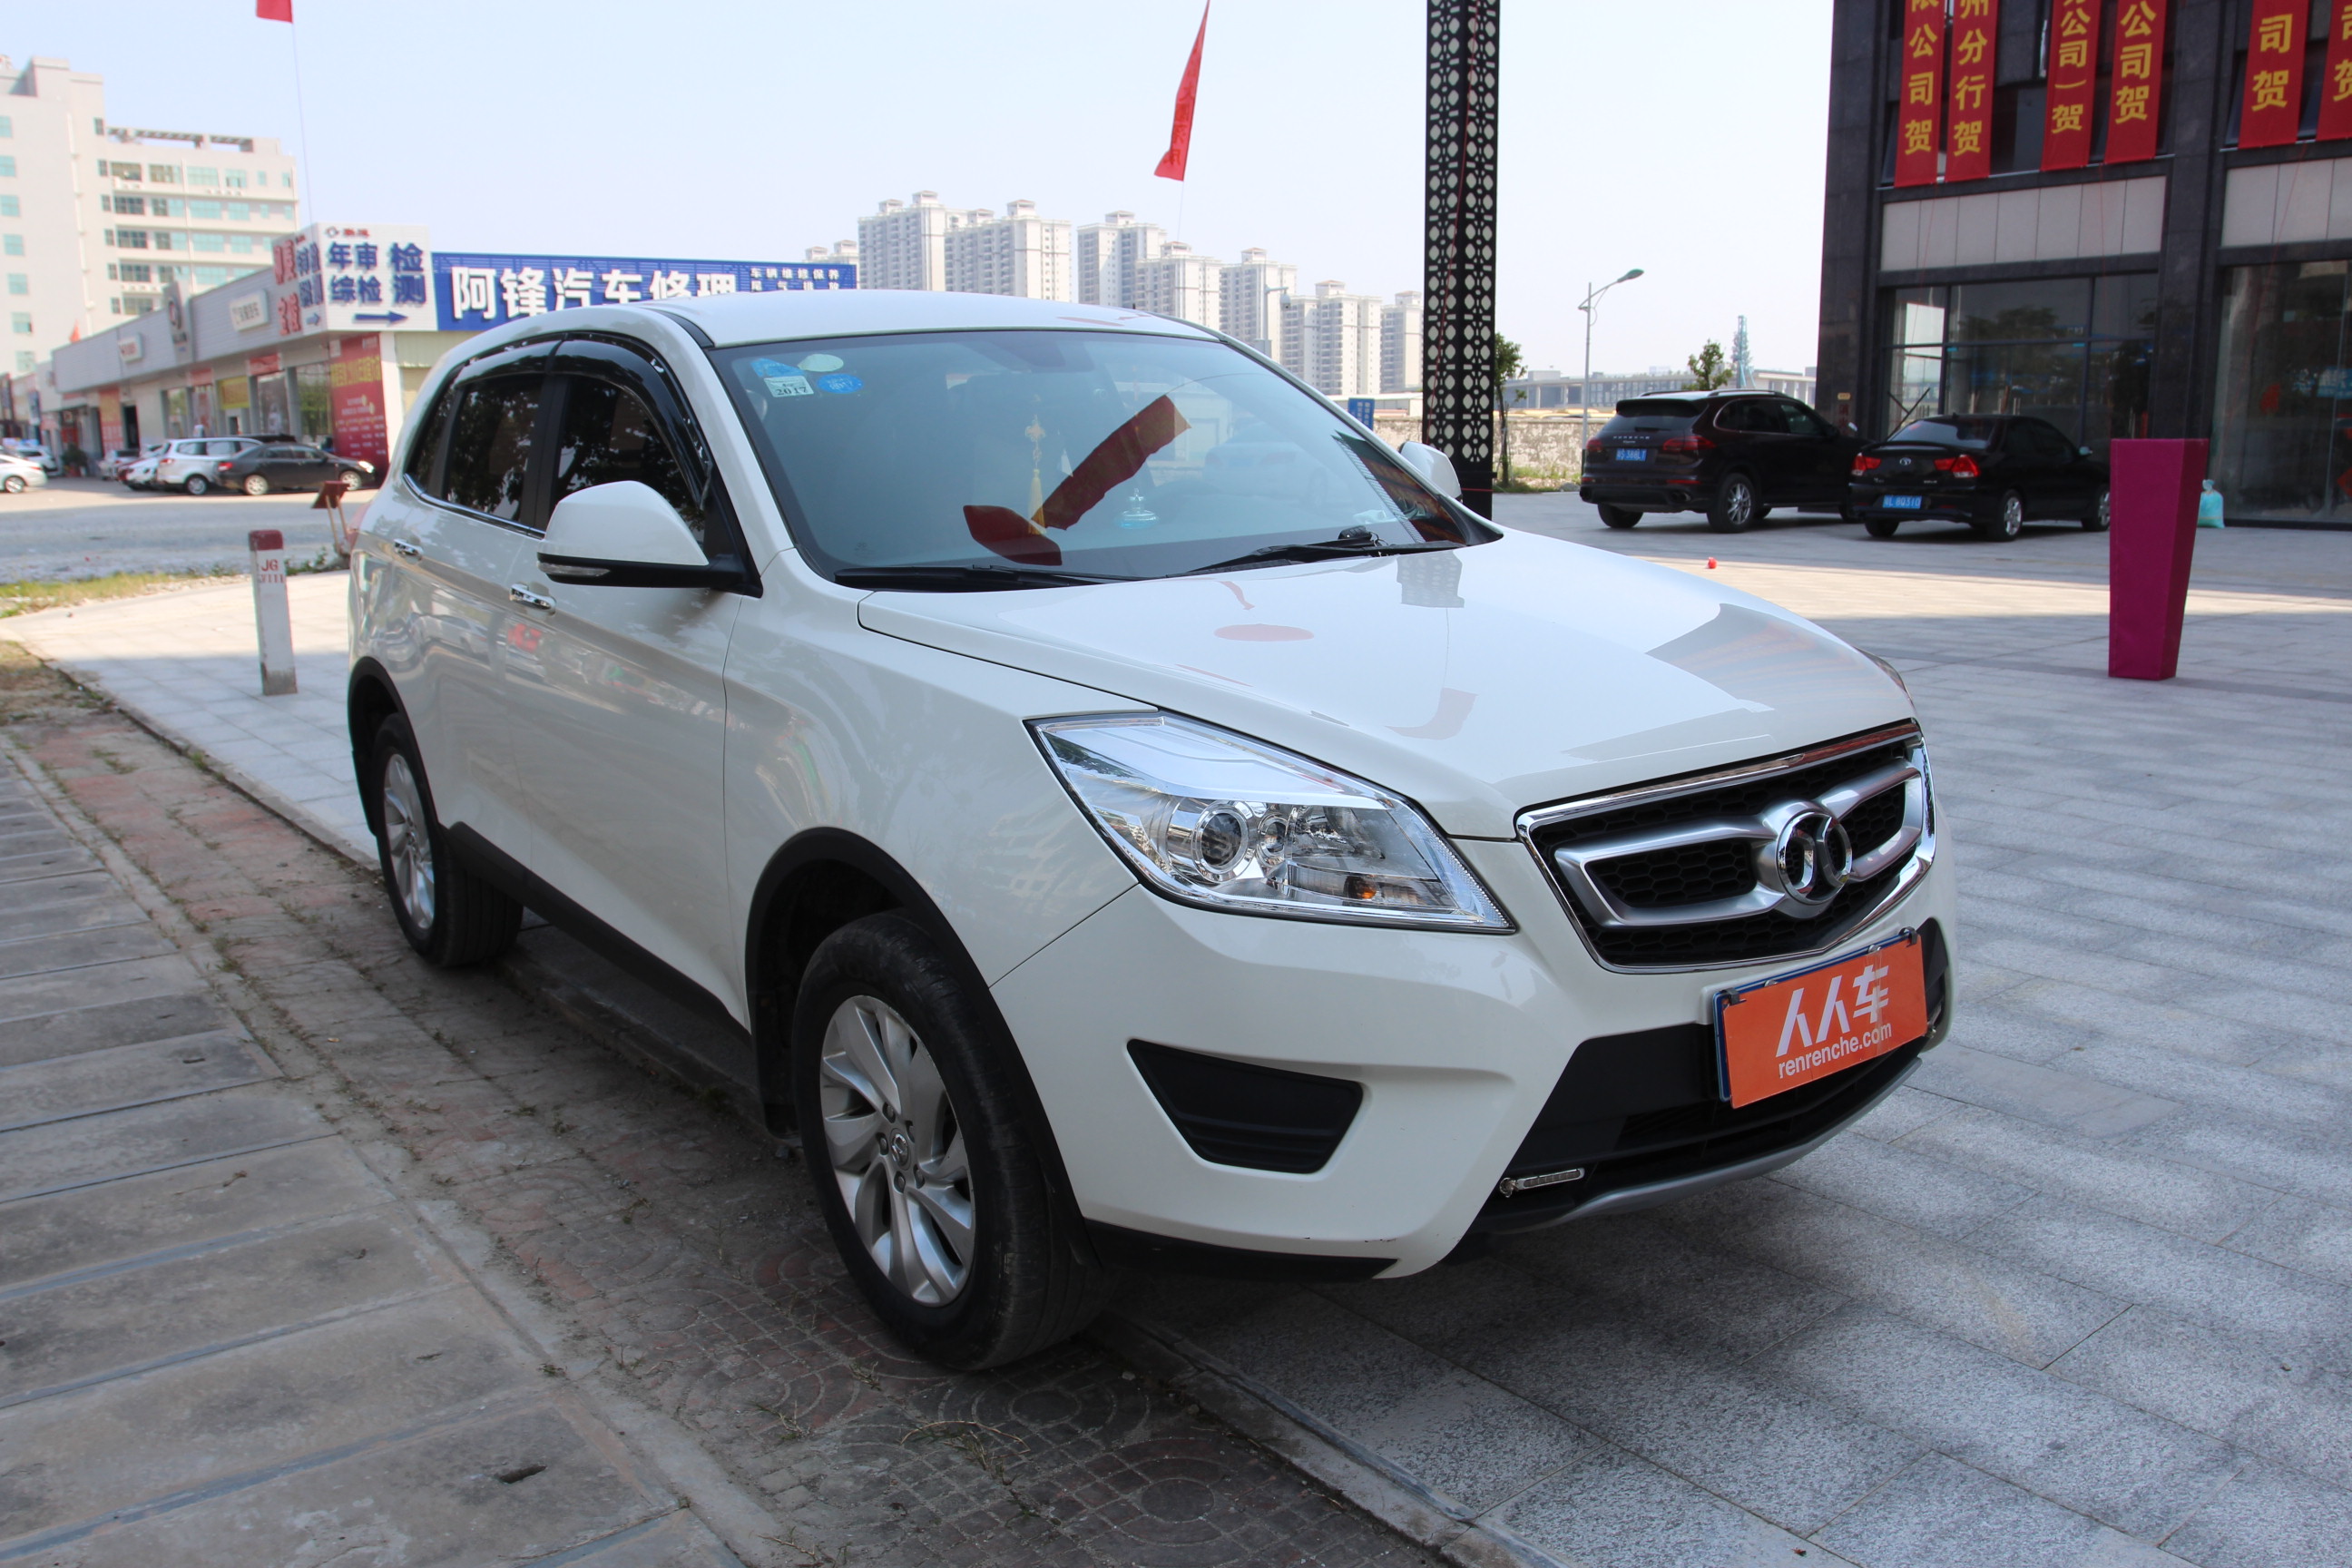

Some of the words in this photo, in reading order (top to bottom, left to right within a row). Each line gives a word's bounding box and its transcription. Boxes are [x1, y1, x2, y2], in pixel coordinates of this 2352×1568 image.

[2115, 0, 2157, 124] 公司贺
[2251, 14, 2293, 113] 司贺
[328, 242, 377, 271] 年审
[391, 242, 426, 304] 检测
[750, 268, 840, 280] 车辆维修保养
[330, 275, 382, 304] 综检
[451, 266, 737, 319] 阿锋汽车修理
[775, 387, 807, 396] 2017
[260, 559, 279, 572] JG
[1776, 965, 1889, 1057] 人人车
[1779, 1023, 1893, 1079] renrenche.com
